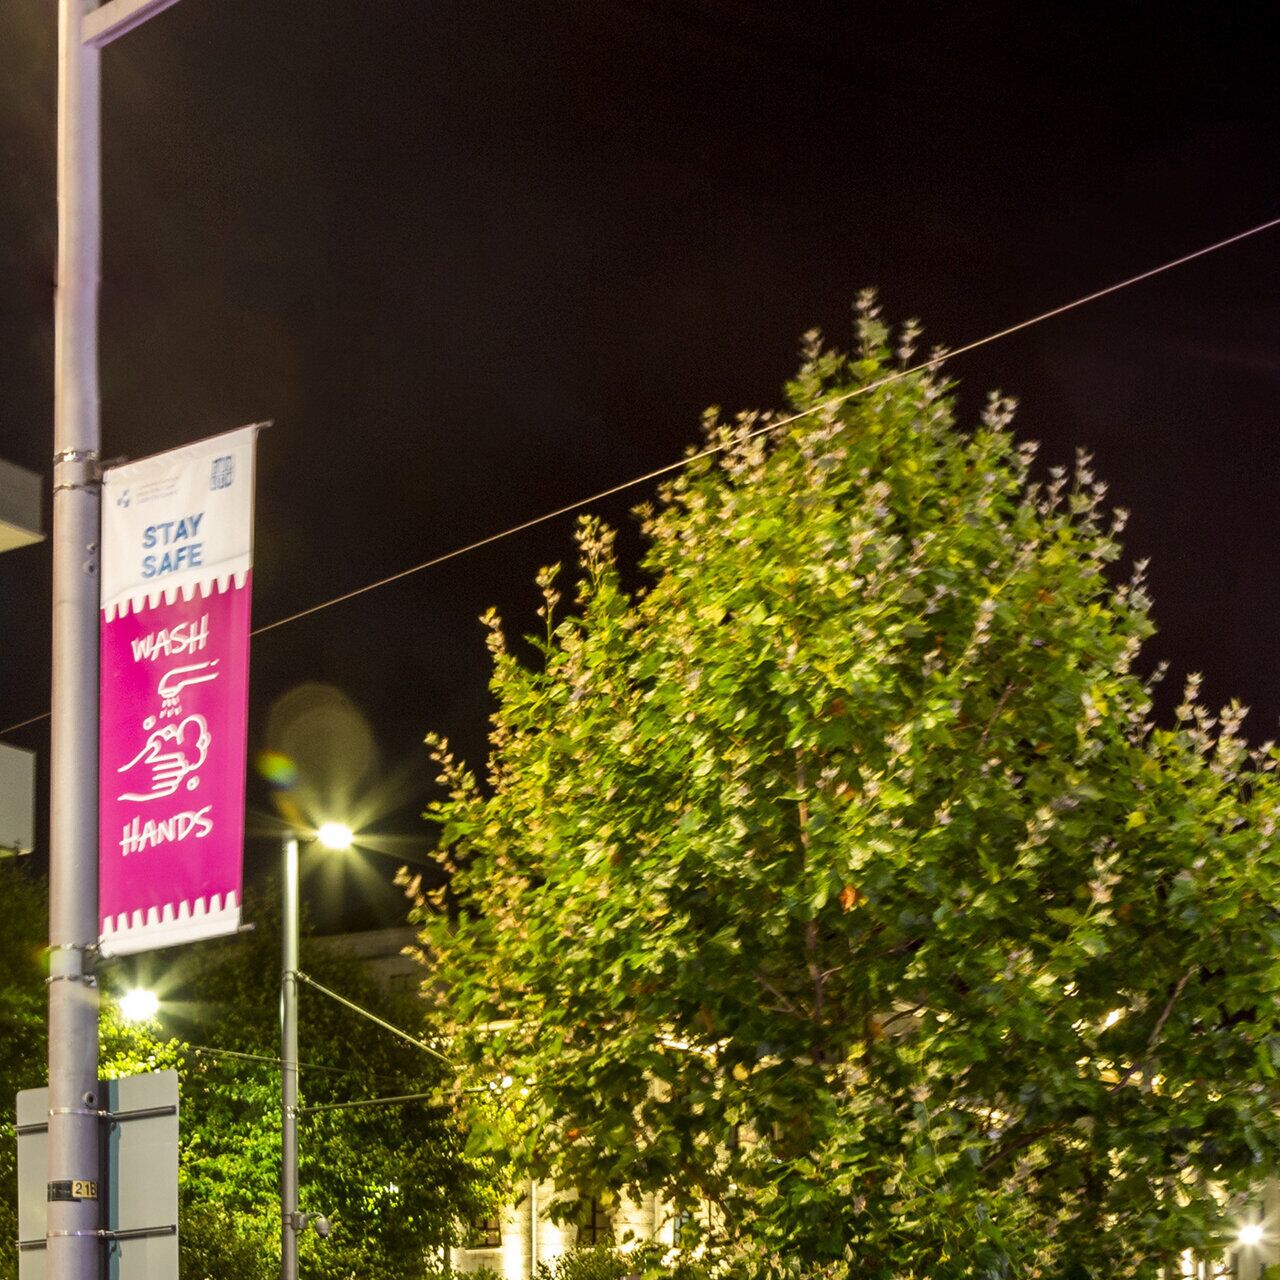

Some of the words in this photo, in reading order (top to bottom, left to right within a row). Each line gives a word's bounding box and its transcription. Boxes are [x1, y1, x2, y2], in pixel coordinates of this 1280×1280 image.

[142, 511, 205, 549] STAY
[141, 542, 204, 579] SAFE
[131, 614, 210, 665] WASH
[120, 804, 214, 858] HANDS
